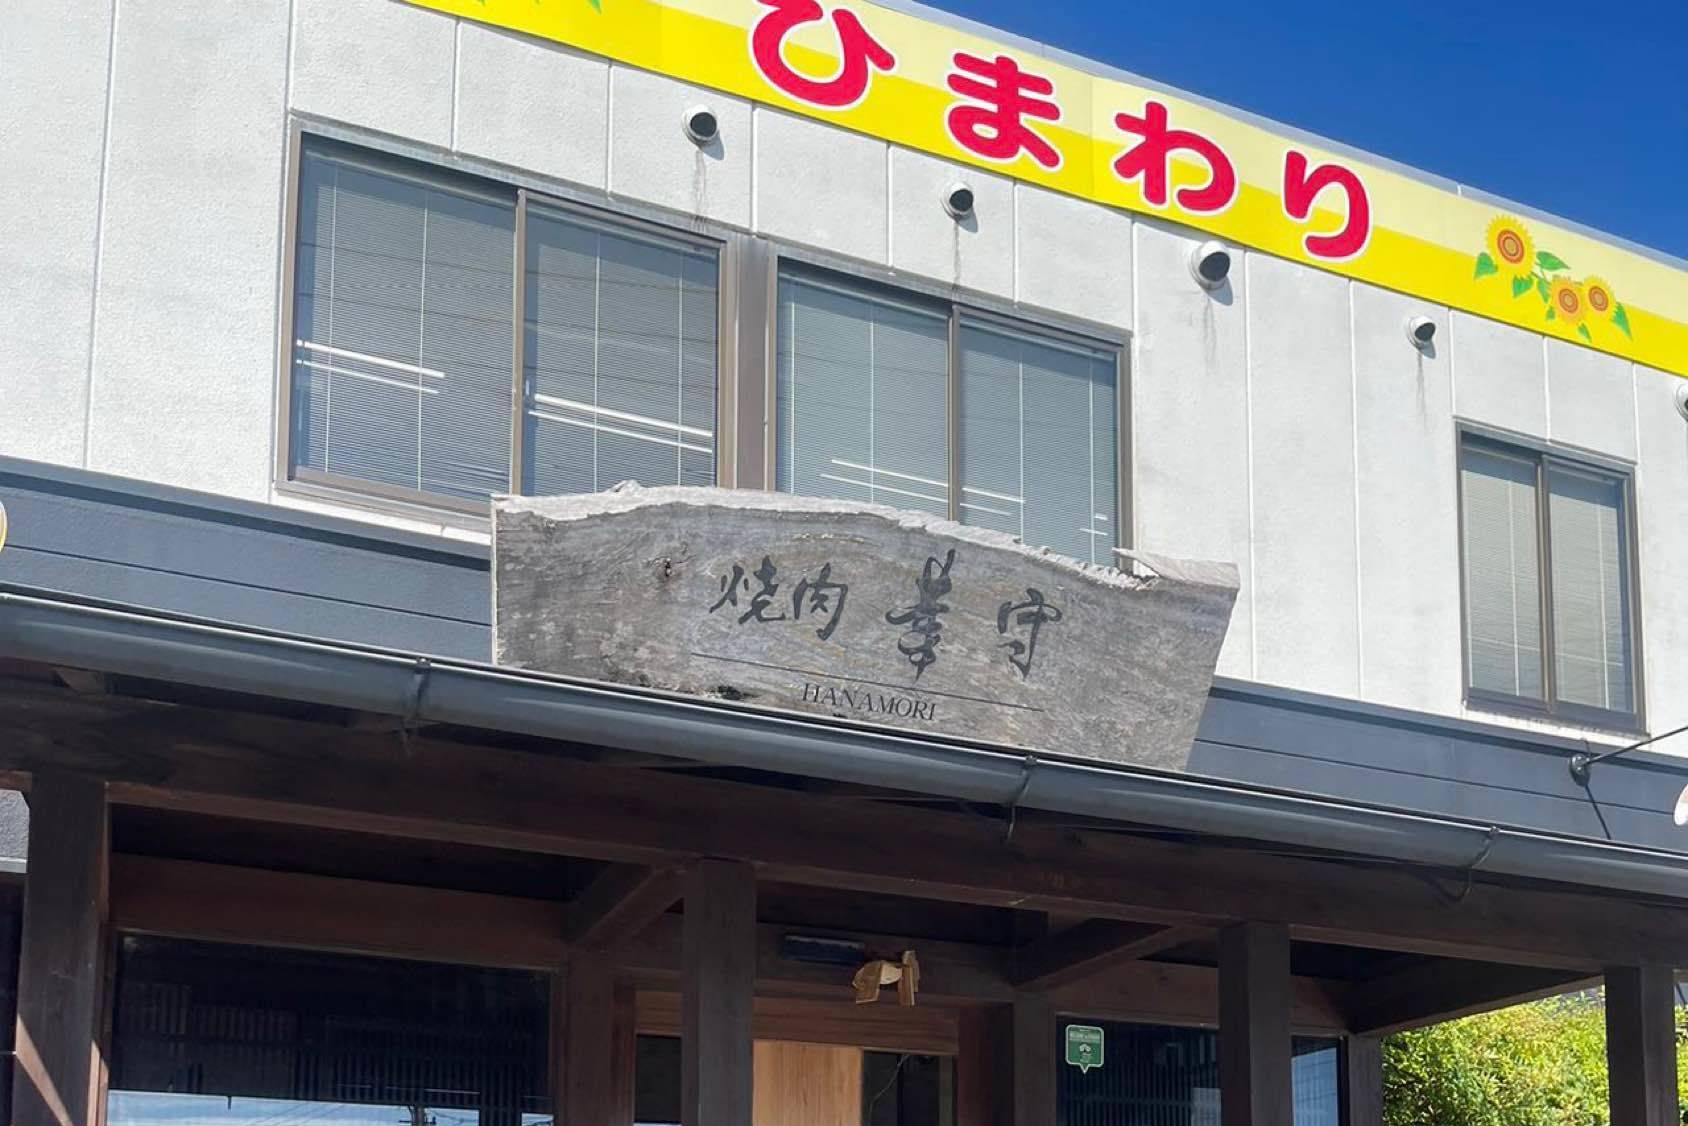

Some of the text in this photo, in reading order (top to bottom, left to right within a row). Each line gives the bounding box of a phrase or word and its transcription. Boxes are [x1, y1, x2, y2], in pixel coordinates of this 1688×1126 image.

[754, 0, 1368, 257] ひまわり
[802, 682, 936, 721] HANAMORI
